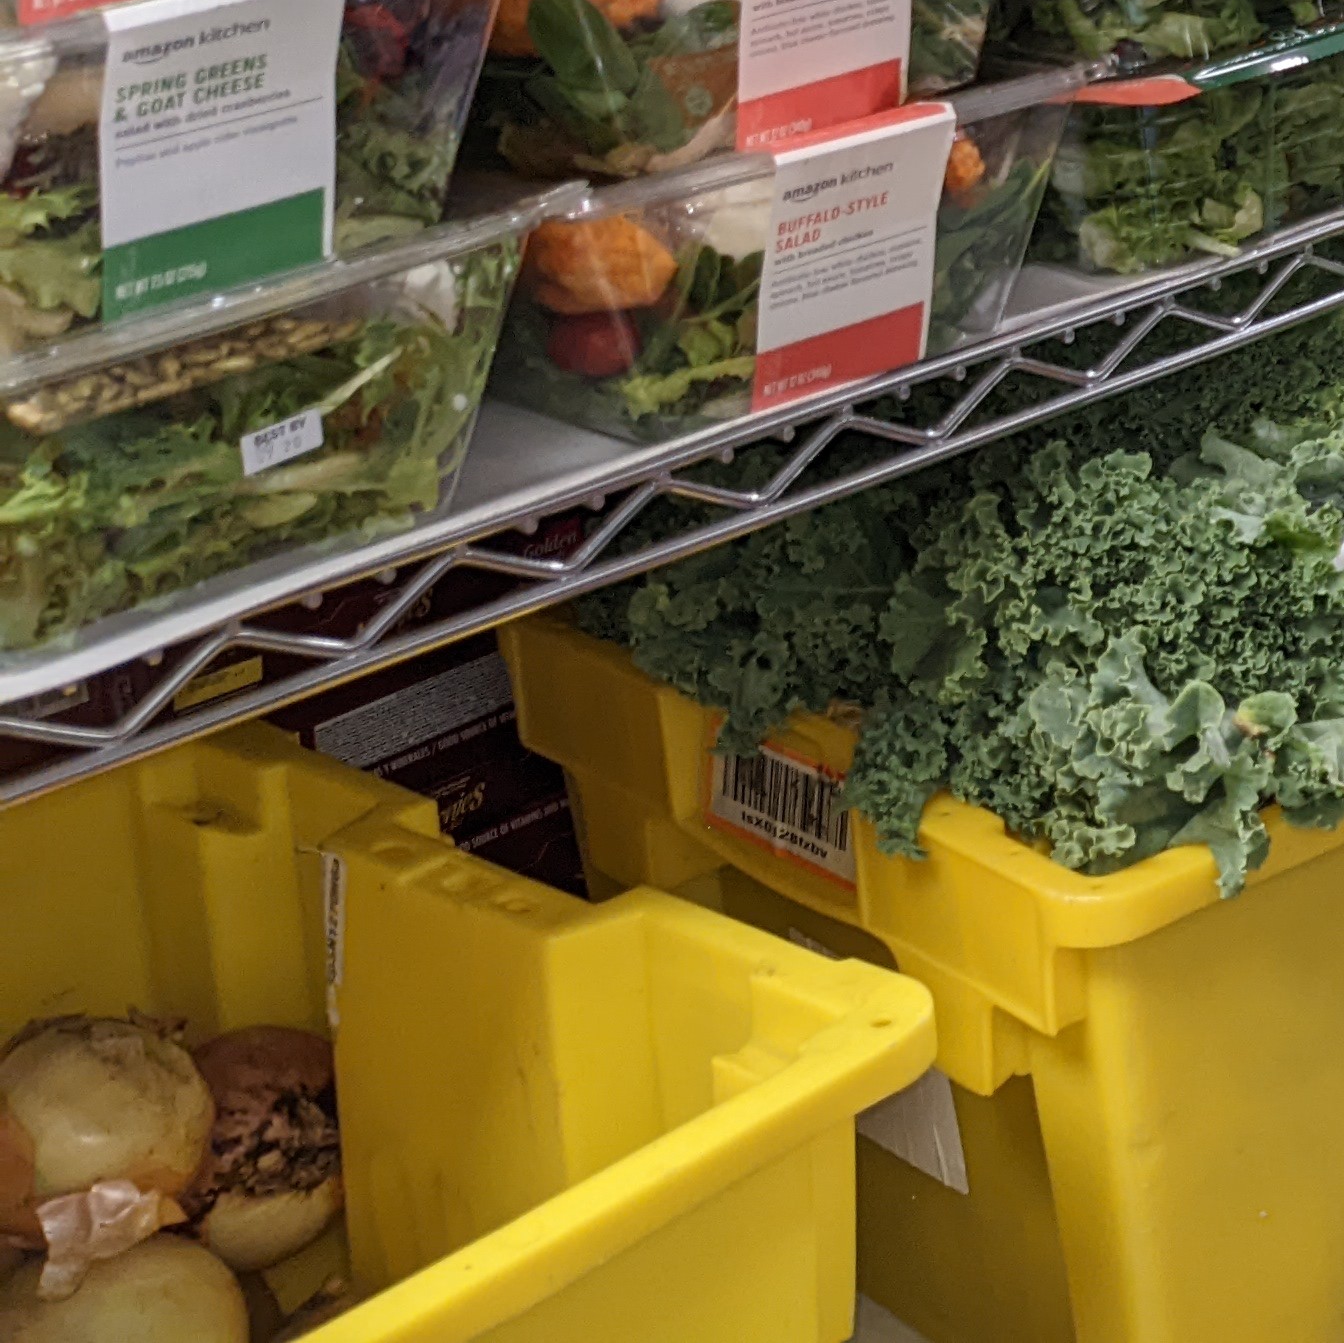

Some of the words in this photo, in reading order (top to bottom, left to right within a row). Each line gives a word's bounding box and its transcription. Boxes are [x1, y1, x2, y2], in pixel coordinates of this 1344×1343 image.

[122, 36, 194, 63] amazon
[199, 19, 271, 46] kitchen
[113, 106, 128, 123] &
[136, 92, 184, 119] GOAT
[193, 73, 265, 105] CHEESE
[116, 71, 187, 103] SPRING
[194, 53, 268, 85] GREENS
[782, 177, 837, 201] amazon
[841, 161, 895, 185] kitchen
[777, 191, 889, 236] BUFFALO-STYLE
[775, 228, 821, 254] SALAD
[254, 425, 285, 446] BEST
